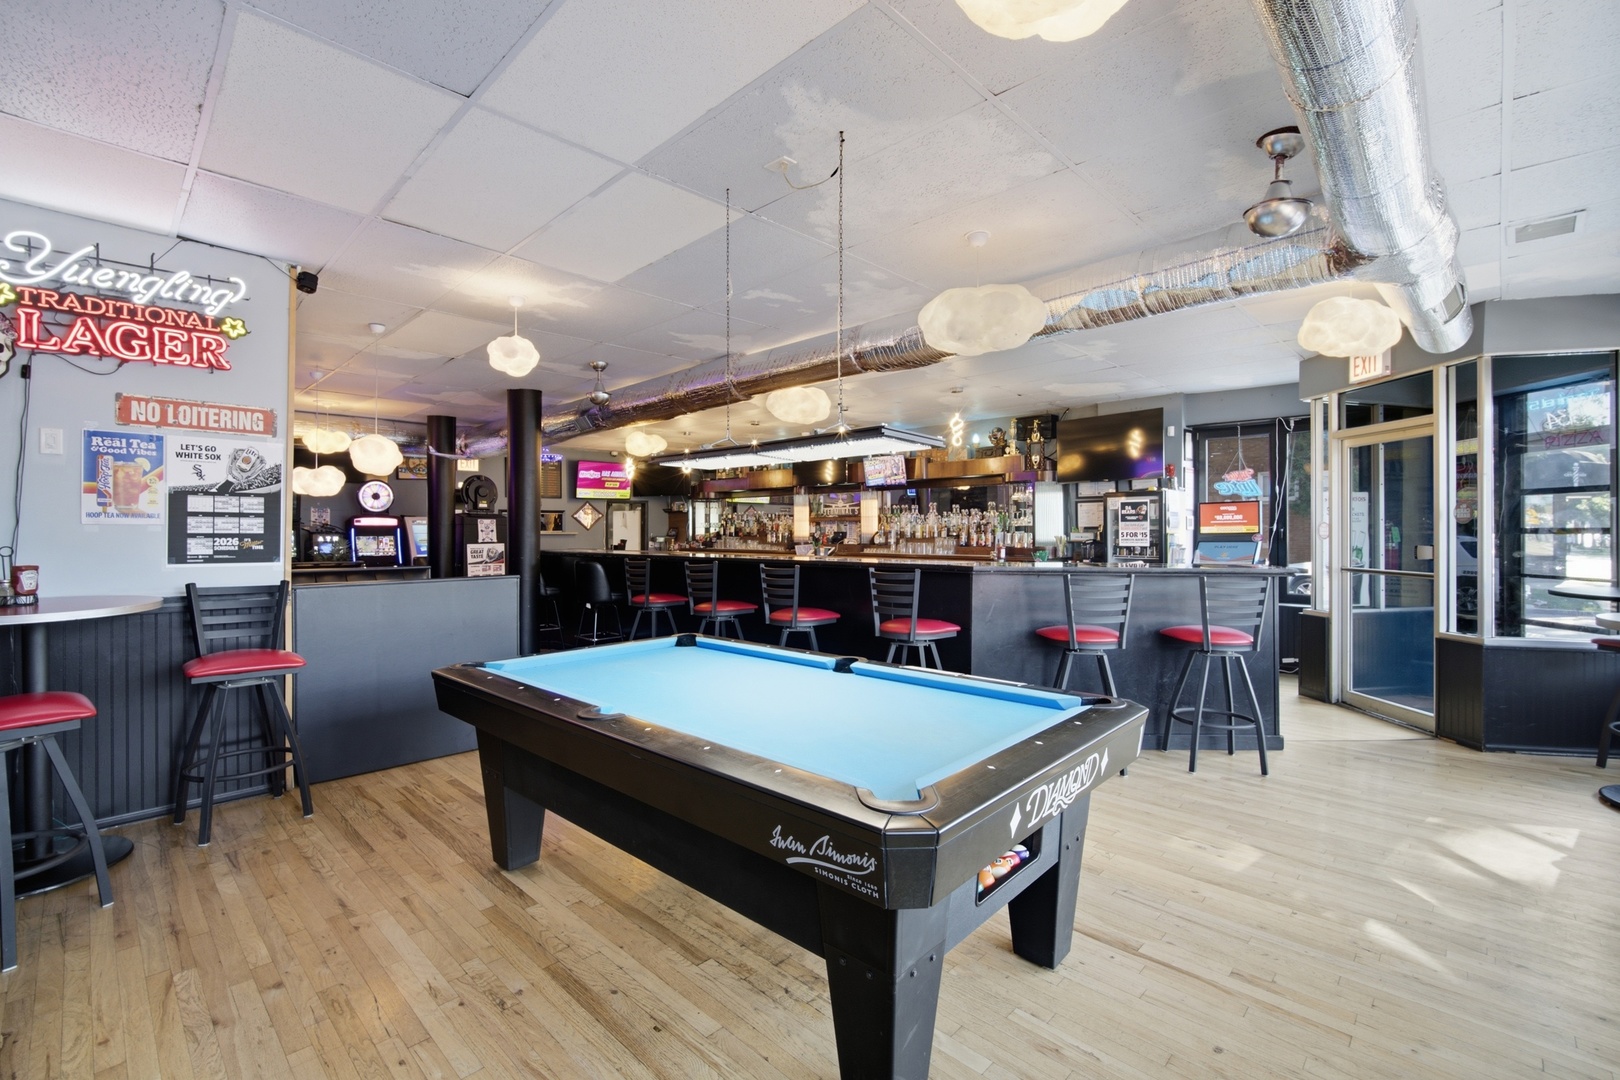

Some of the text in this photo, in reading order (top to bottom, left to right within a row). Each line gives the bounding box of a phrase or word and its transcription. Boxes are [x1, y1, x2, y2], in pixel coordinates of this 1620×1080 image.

[0, 230, 246, 315] Yuengling
[16, 286, 221, 332] TRADITIONAL
[16, 308, 232, 370] LAGER
[1353, 355, 1377, 377] EXIT
[130, 400, 264, 431] NO LOITERING
[91, 436, 157, 450] Real Tea
[128, 448, 157, 456] Vibes
[180, 444, 203, 452] LET'S
[175, 451, 204, 460] WHITE
[205, 453, 222, 461] SOX
[85, 511, 103, 519] HOOP
[103, 511, 115, 519] TEA
[213, 537, 239, 546] 2026
[1026, 752, 1100, 828] DIAMOND
[814, 866, 879, 899] SIMONIS CLOTH
